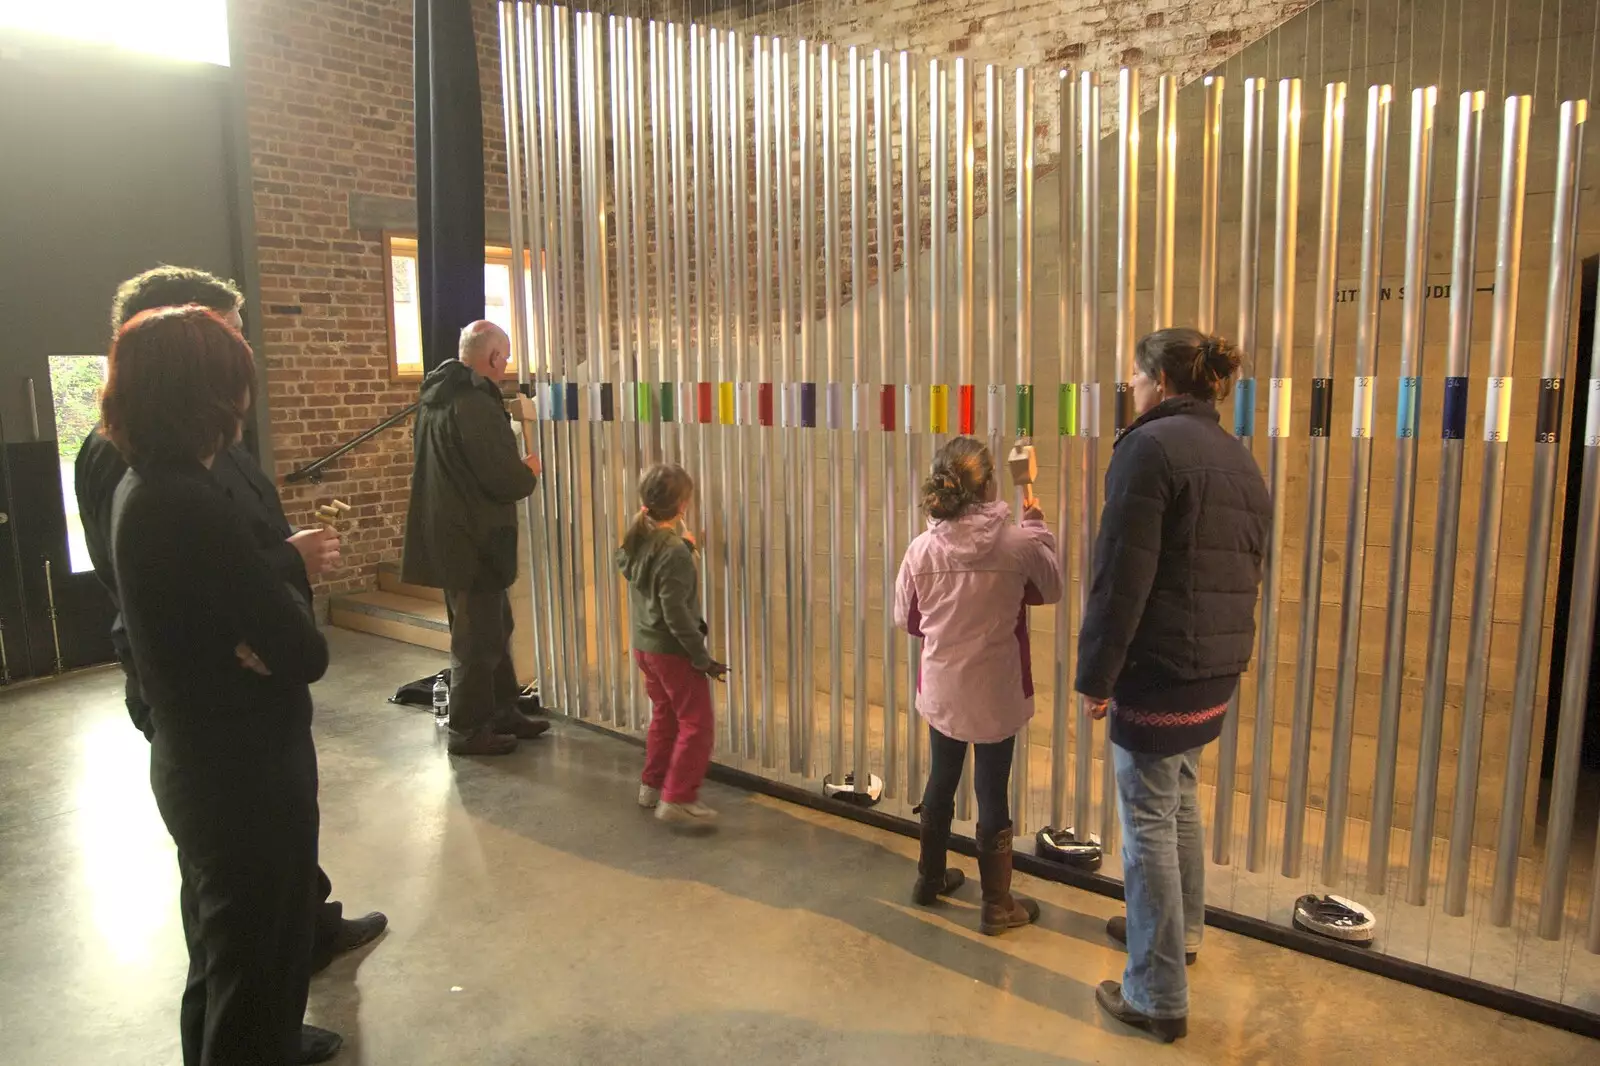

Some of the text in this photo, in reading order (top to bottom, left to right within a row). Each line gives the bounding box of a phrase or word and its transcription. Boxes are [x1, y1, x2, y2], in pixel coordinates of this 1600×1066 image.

[1273, 380, 1283, 388] 30
[1316, 379, 1326, 388] 31
[1358, 378, 1368, 387] 32
[1404, 378, 1416, 388] 33
[1447, 378, 1460, 388] 34
[1492, 378, 1504, 388] 35
[1545, 379, 1560, 390] 36
[932, 385, 941, 394] 20
[1018, 386, 1028, 394] 23
[1116, 383, 1127, 392] 26
[1017, 428, 1026, 437] 23
[1270, 428, 1280, 436] 30
[1312, 428, 1323, 436] 31
[1355, 428, 1365, 437] 32
[1400, 428, 1412, 438] 33
[1444, 429, 1456, 439] 34
[1488, 431, 1500, 441] 35
[1540, 432, 1555, 443] 36
